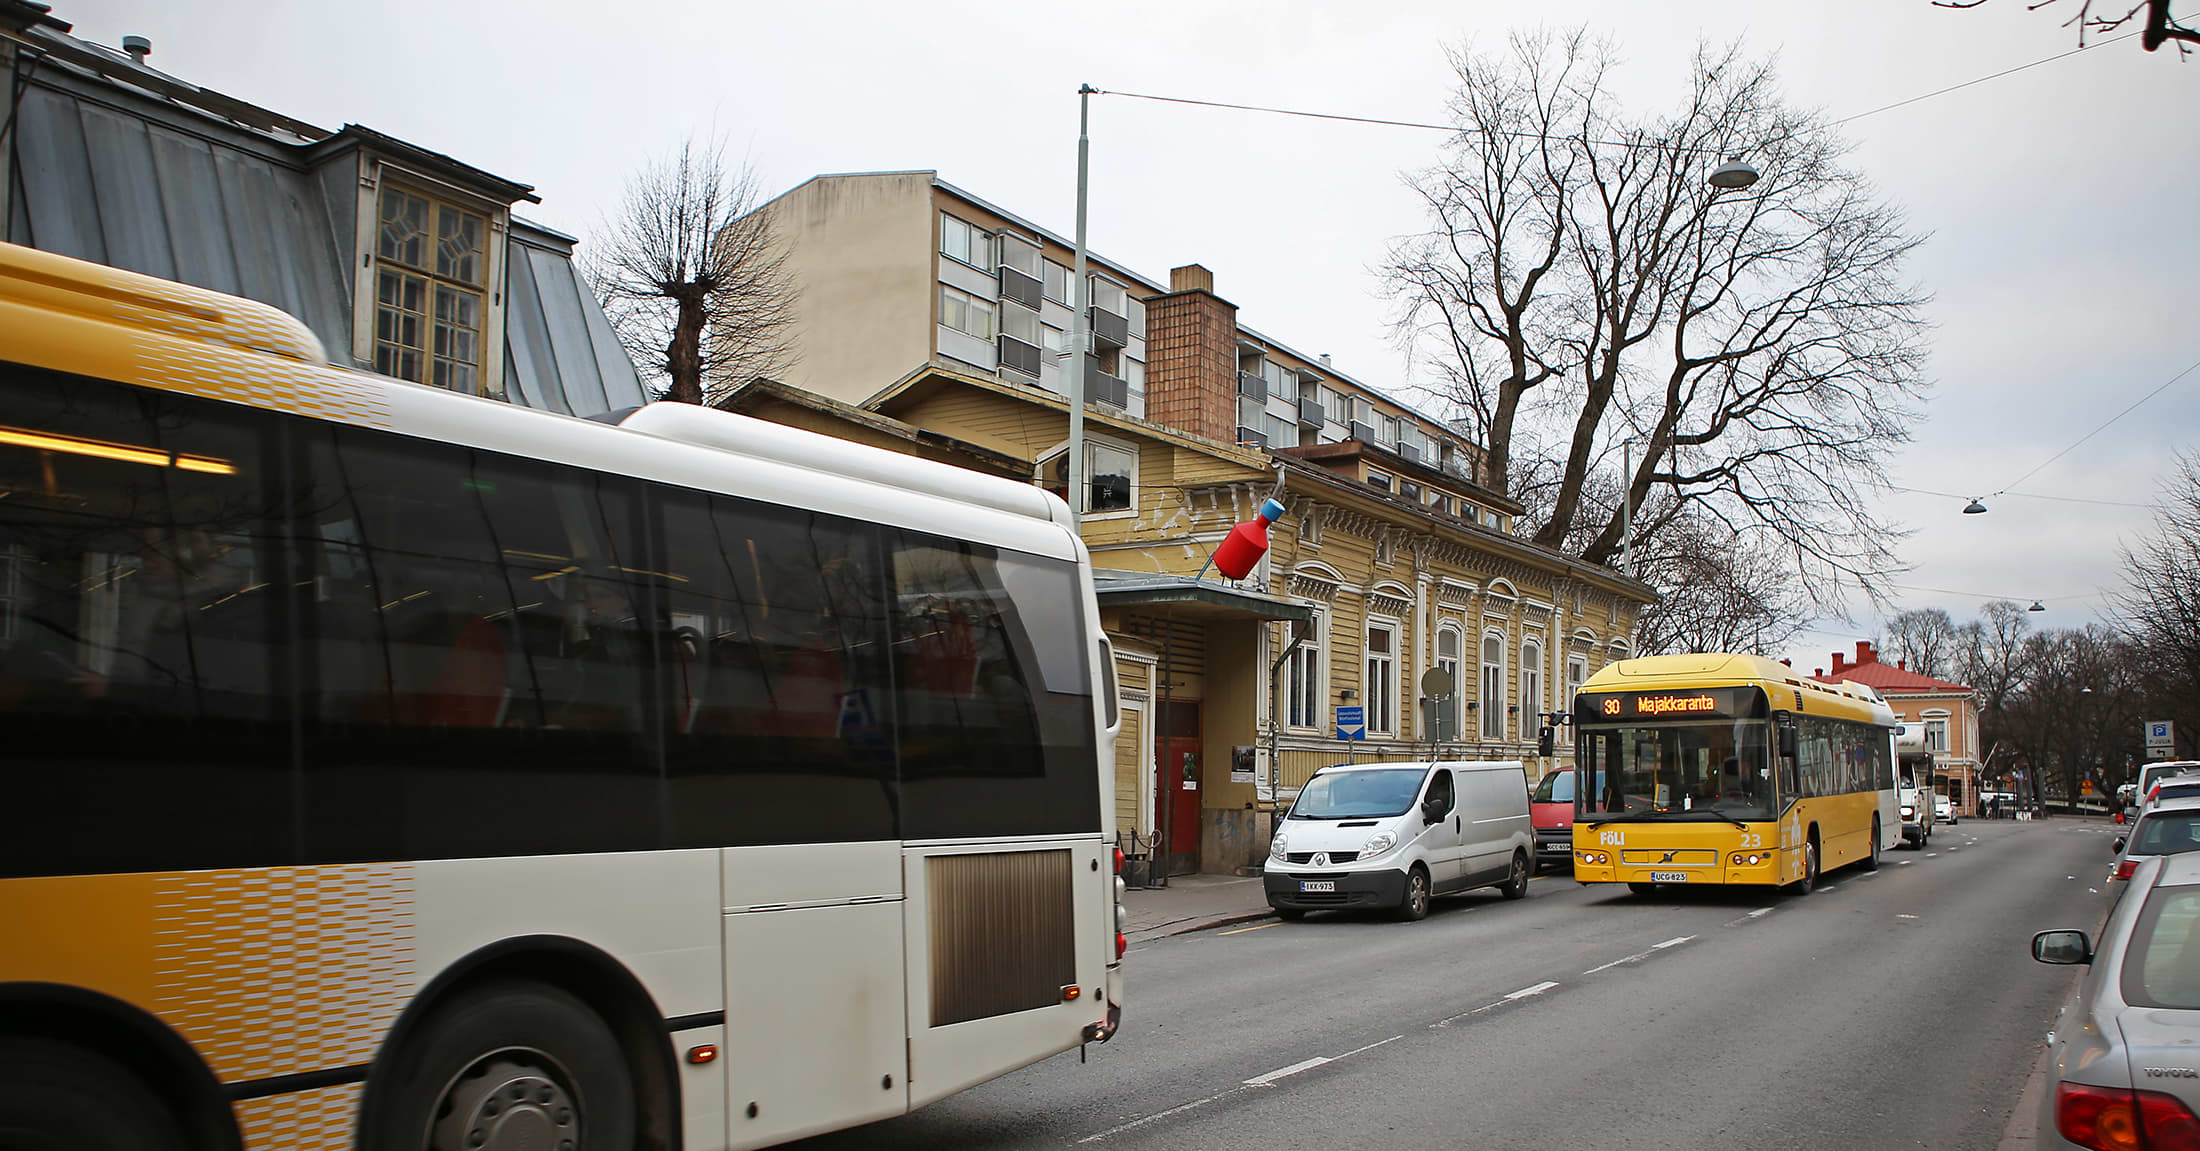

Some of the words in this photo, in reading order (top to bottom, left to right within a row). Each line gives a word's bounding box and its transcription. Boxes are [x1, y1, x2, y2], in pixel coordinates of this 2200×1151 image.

[1604, 699, 1621, 715] 30
[1638, 695, 1714, 715] Majakkaranta
[1740, 833, 1761, 848] 23
[2144, 1066, 2199, 1079] TOYOTA
